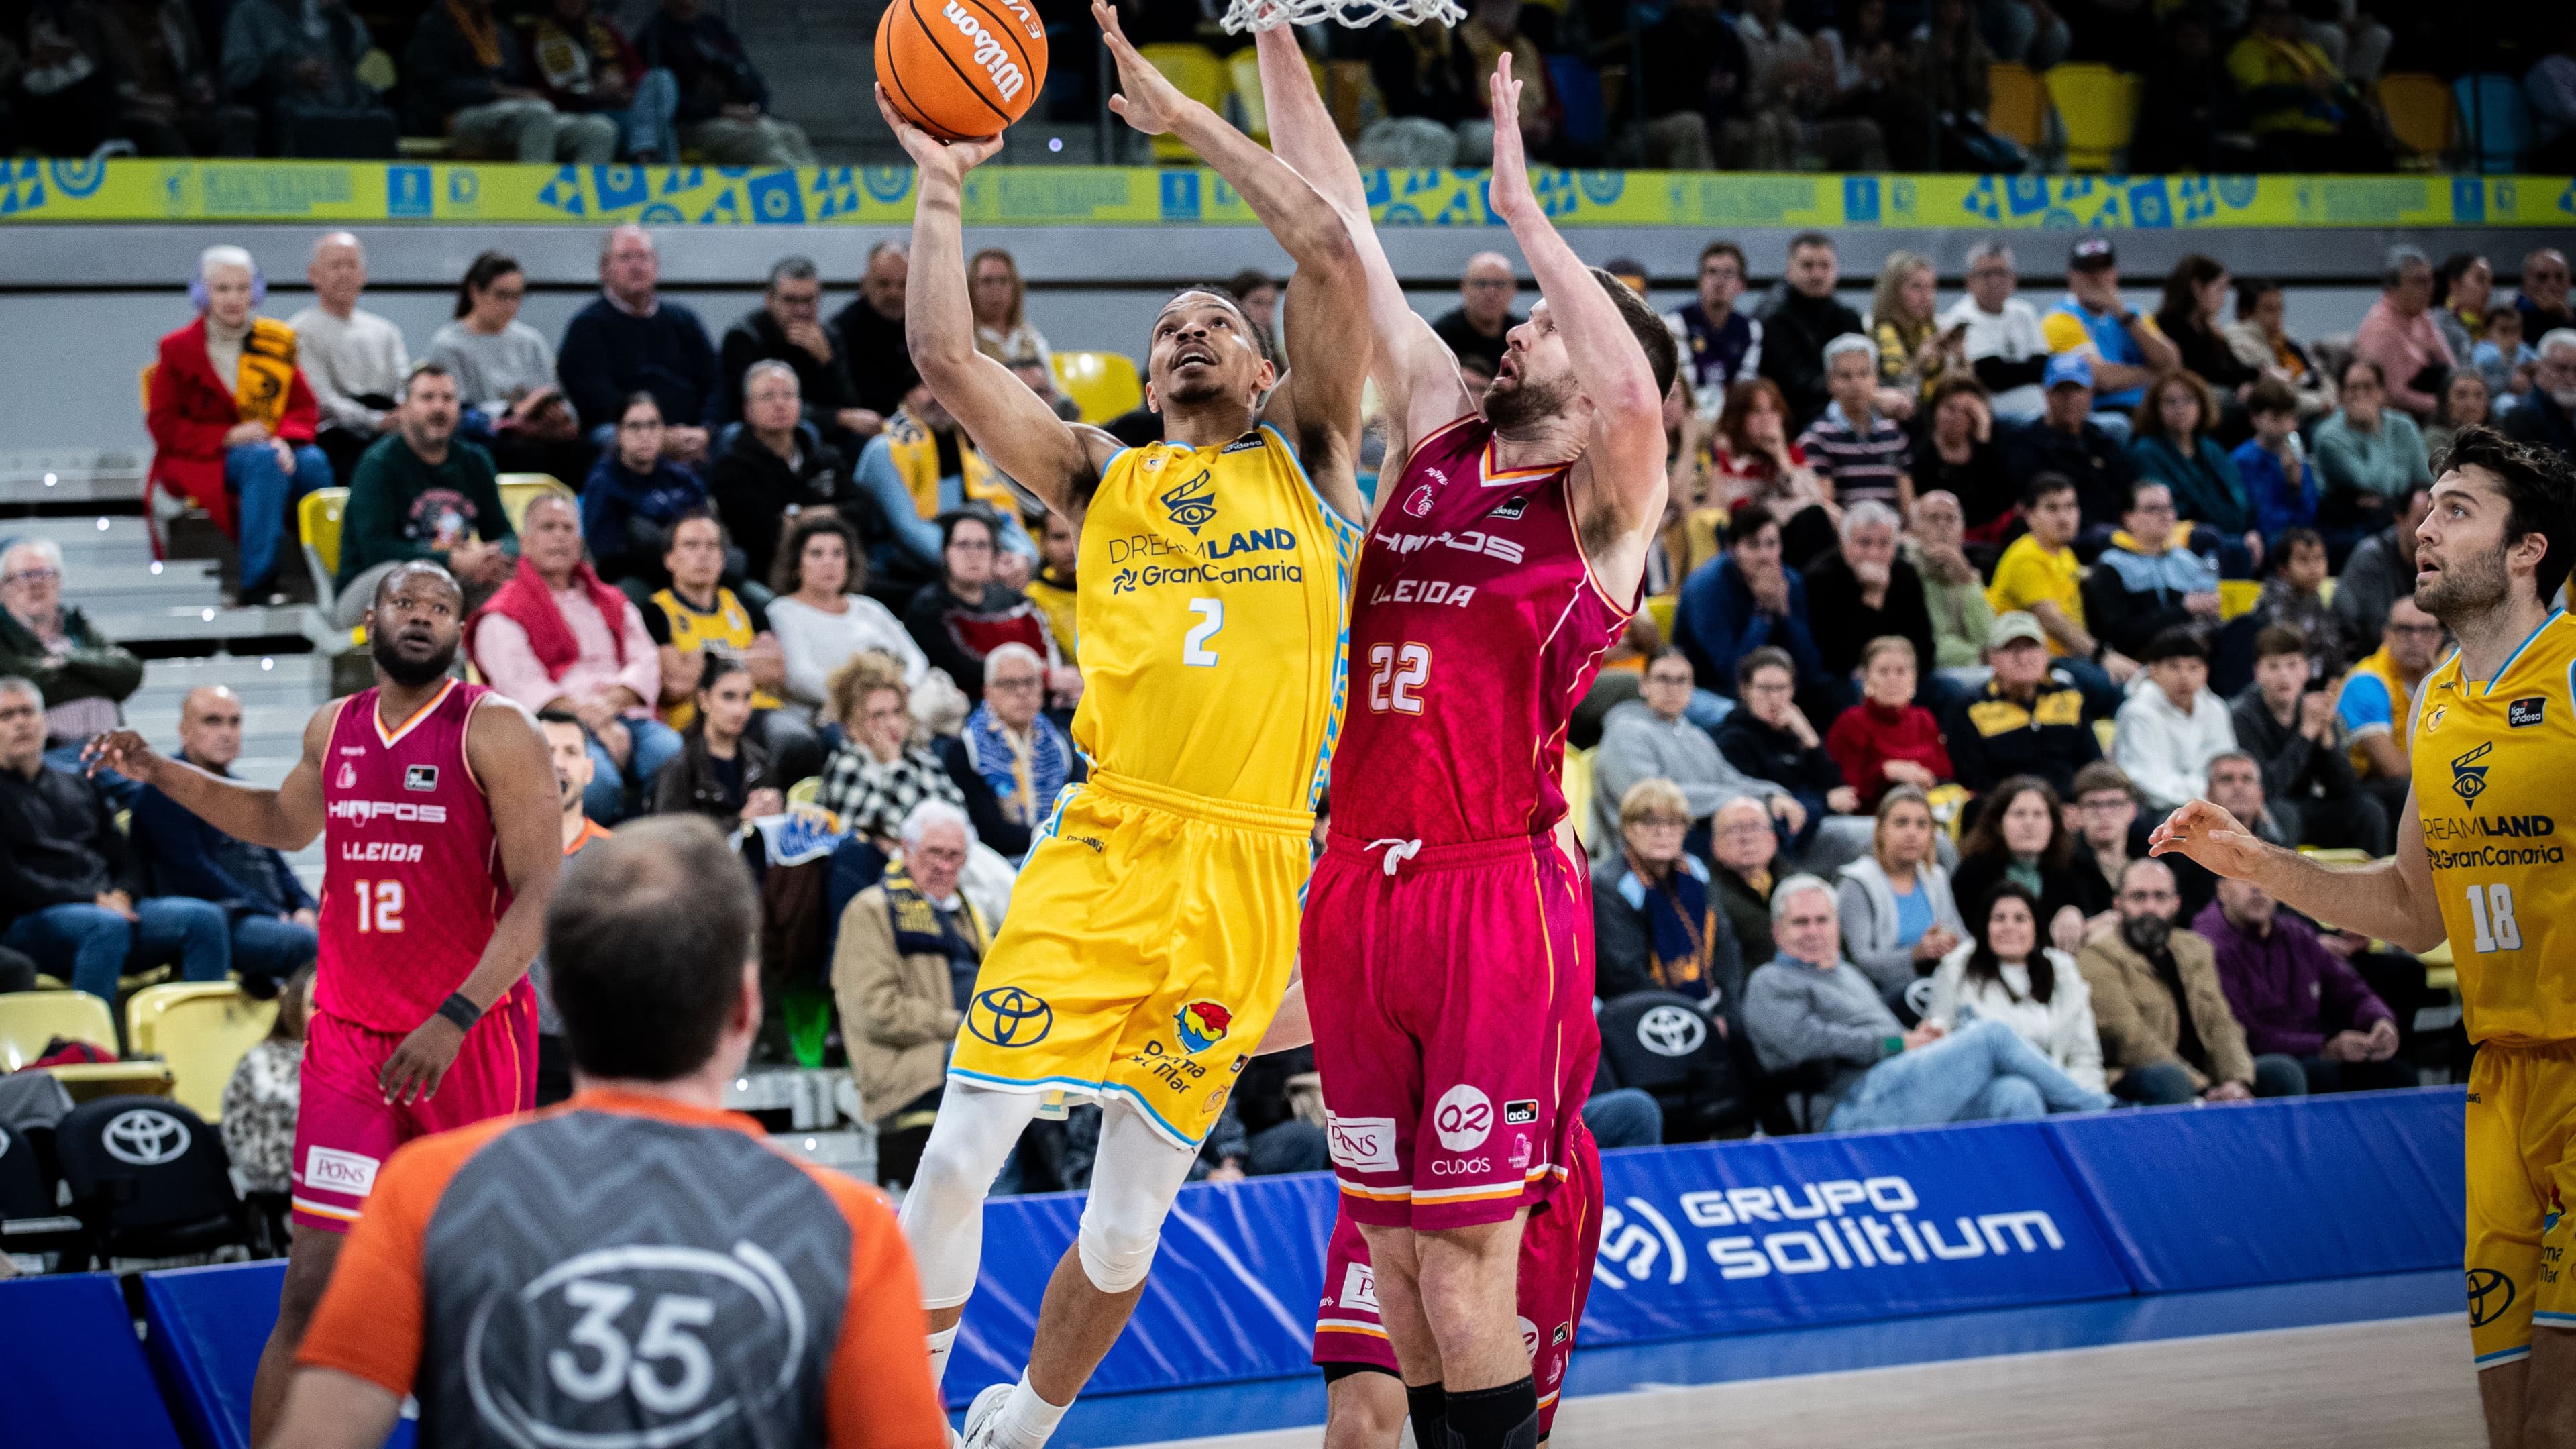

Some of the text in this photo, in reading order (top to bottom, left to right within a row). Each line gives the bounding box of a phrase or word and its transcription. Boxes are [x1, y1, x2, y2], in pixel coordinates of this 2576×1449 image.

[1002, 0, 1042, 39] EV
[945, 0, 1024, 103] Wilson
[1142, 560, 1302, 586] GranCanaria
[1183, 598, 1224, 667] 2
[1368, 641, 1432, 716] 22
[2511, 706, 2526, 716] liga
[2511, 712, 2542, 724] endesa
[2422, 815, 2555, 840] REAMLAND
[343, 841, 424, 863] LLEIDA
[2442, 844, 2565, 869] GranCanaria
[354, 879, 405, 934] 12
[2466, 883, 2522, 953] 18
[1152, 1062, 1191, 1095] Mar
[1438, 1103, 1489, 1133] Q2
[1508, 1109, 1531, 1121] acb
[317, 1158, 366, 1185] PONS
[1680, 1175, 1919, 1227] GRUPO
[1706, 1210, 2066, 1280] solitium
[547, 1279, 716, 1414] 35
